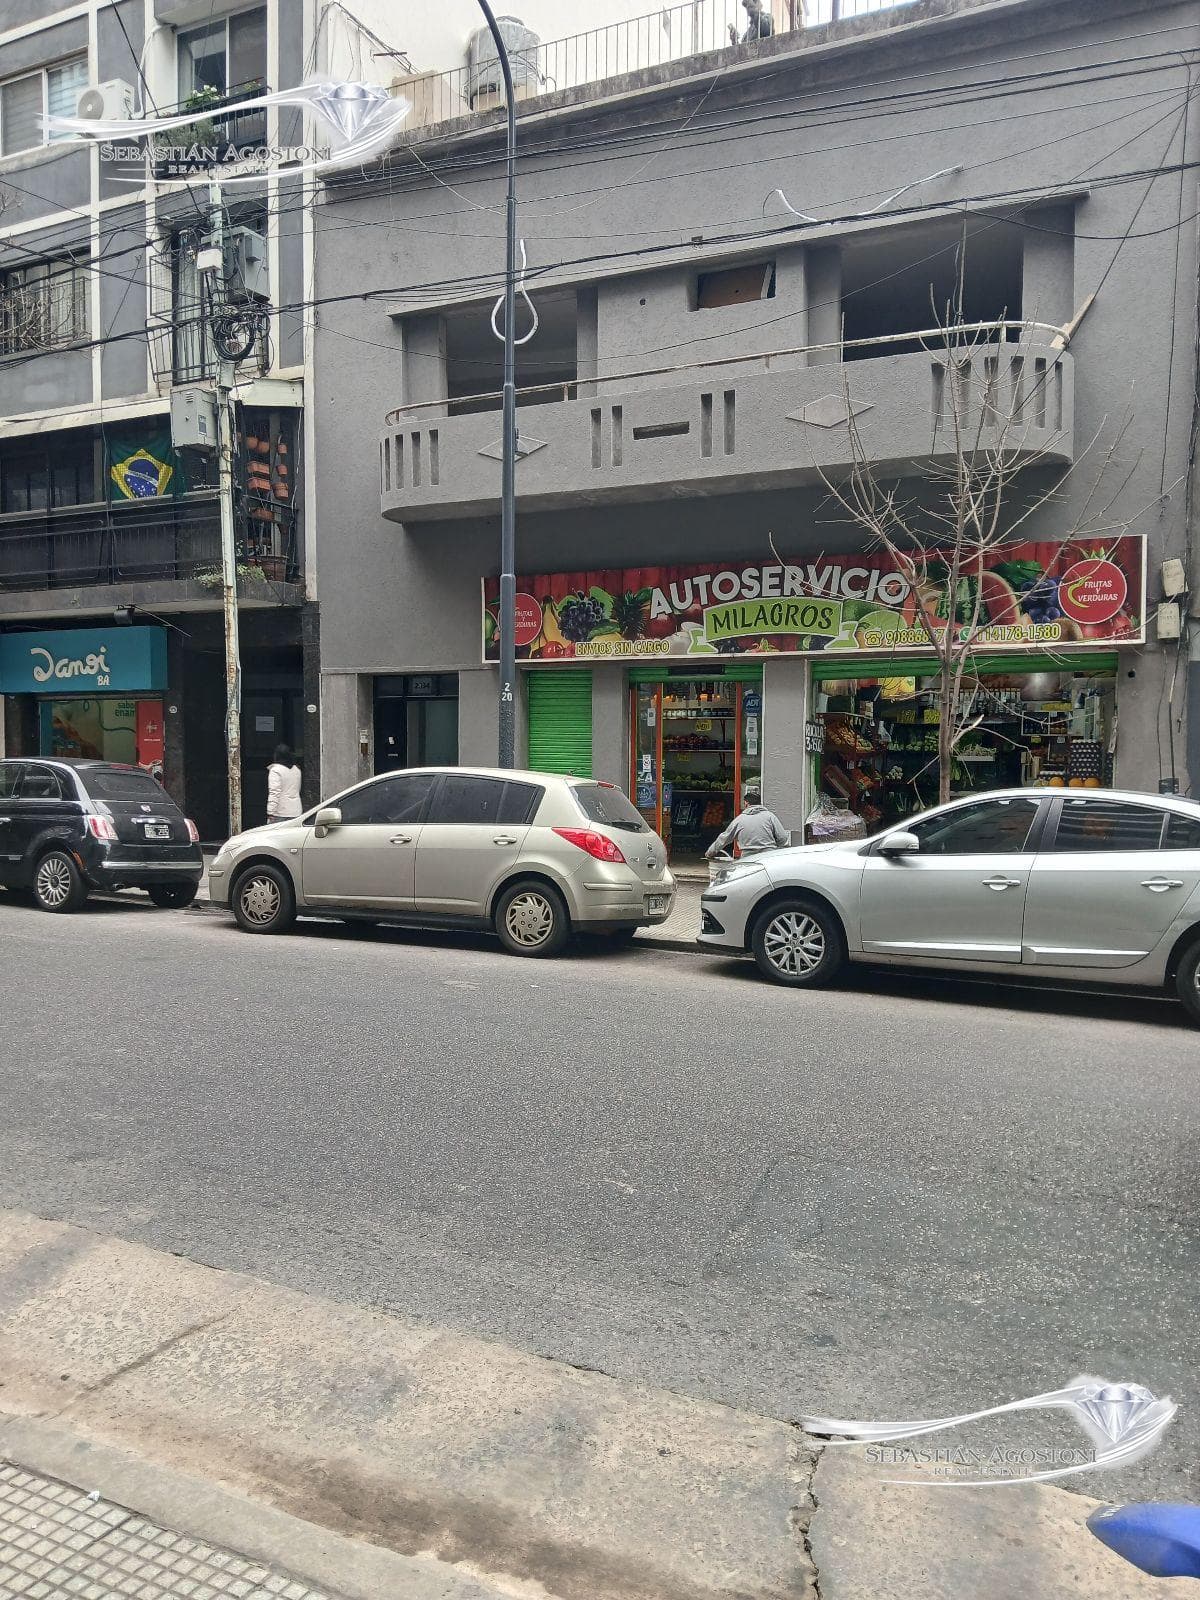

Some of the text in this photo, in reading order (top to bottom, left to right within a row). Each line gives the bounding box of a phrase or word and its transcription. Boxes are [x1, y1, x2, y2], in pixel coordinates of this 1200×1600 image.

[1084, 580, 1113, 588] FRUTAS
[650, 565, 911, 620] AUTOSERVICIO
[1078, 593, 1119, 602] VERDURAS
[711, 603, 834, 634] MILAGROS
[576, 640, 670, 656] ENVIOS SIN CARGO
[97, 675, 110, 686] BA
[504, 682, 510, 691] 2
[502, 691, 512, 701] 20
